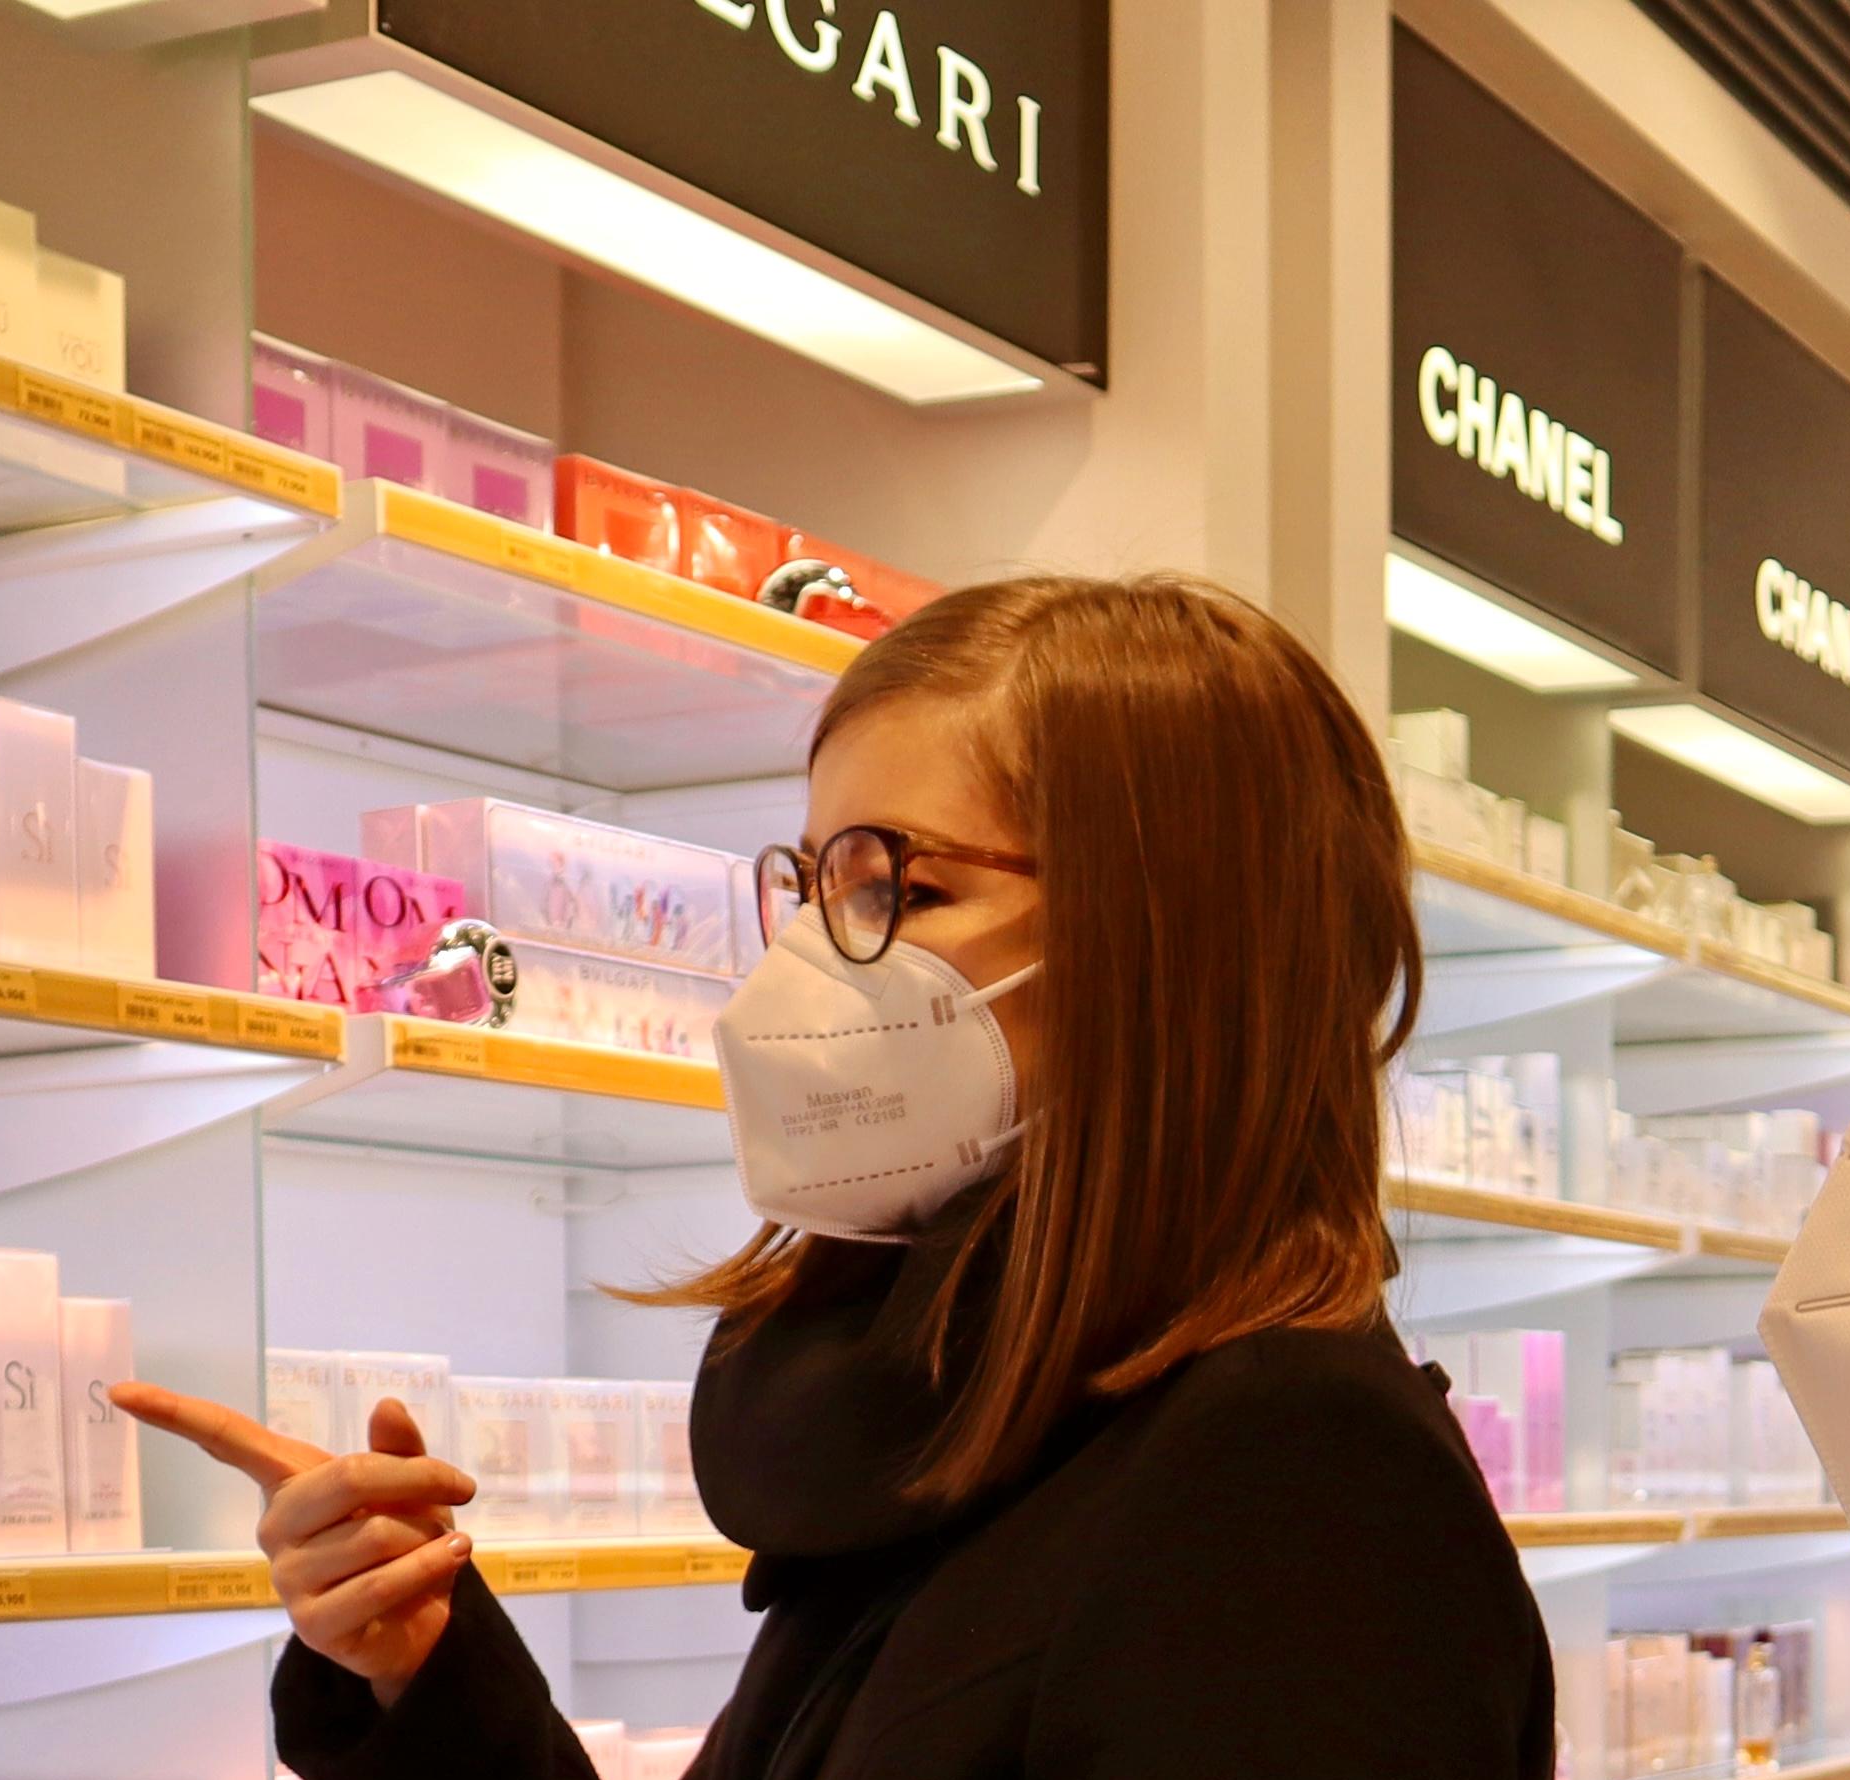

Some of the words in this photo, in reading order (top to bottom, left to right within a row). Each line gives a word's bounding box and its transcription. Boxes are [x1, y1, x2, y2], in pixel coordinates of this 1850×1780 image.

[1417, 345, 1623, 545] CHANEL
[805, 1086, 874, 1109] Masvan
[3, 1360, 38, 1412] Sì
